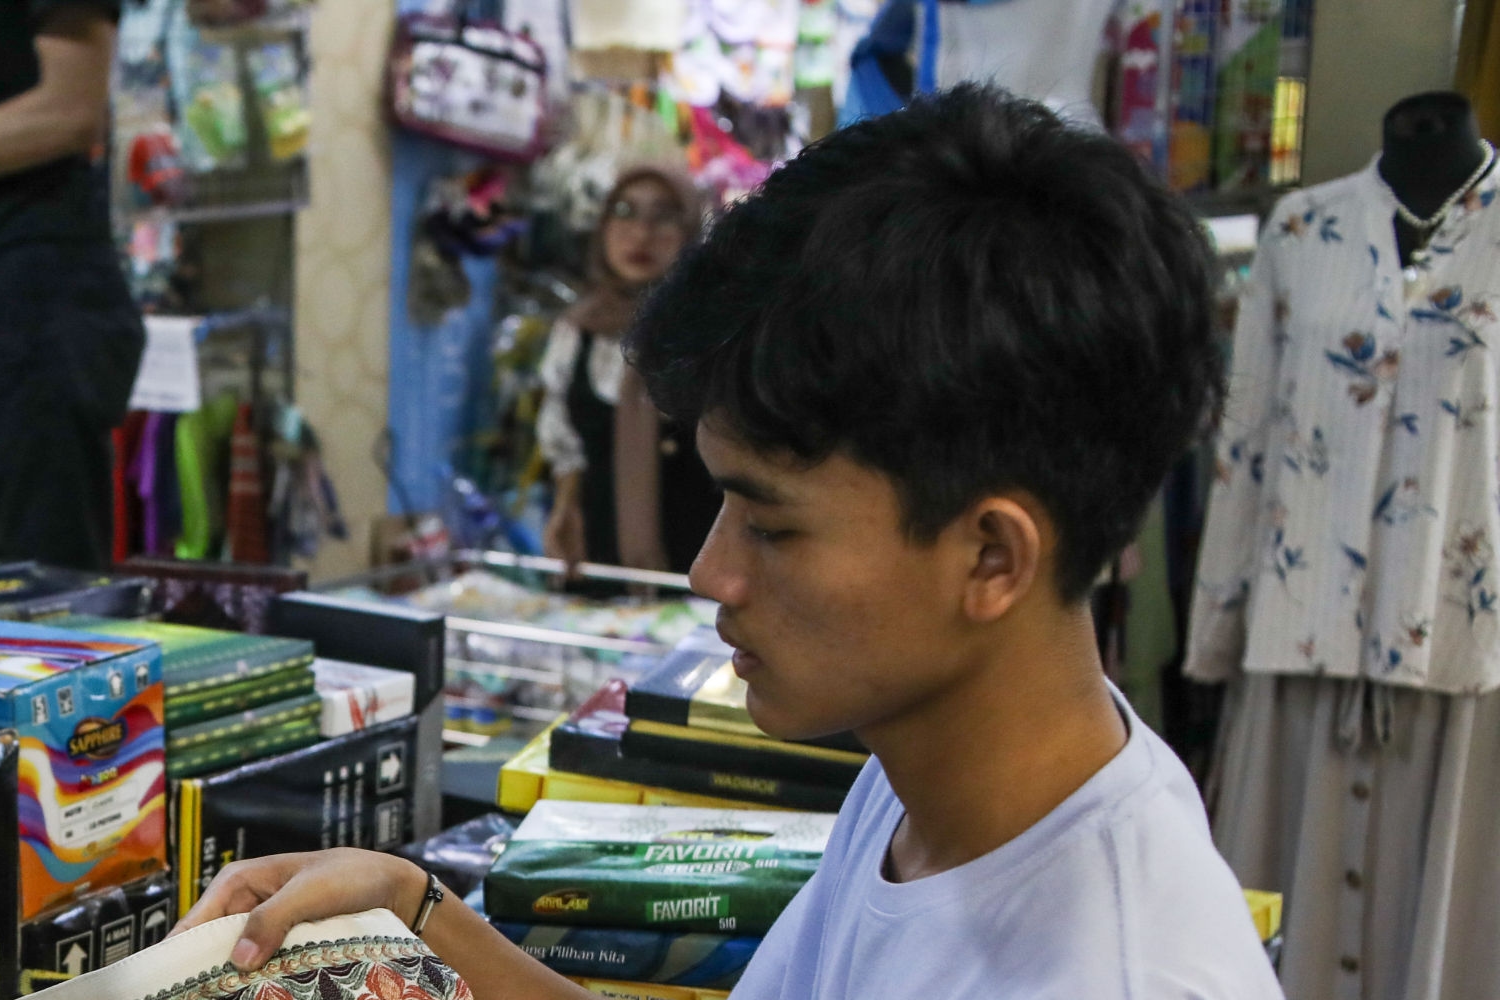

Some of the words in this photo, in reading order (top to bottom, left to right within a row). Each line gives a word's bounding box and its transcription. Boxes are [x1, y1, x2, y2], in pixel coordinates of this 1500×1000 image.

[69, 723, 124, 756] SAPPHIRE
[712, 773, 777, 795] WADIMOR
[644, 844, 760, 862] FAVORIT
[653, 892, 721, 921] FAVORIT
[550, 945, 595, 961] Pilihan
[598, 950, 626, 964] Kita
